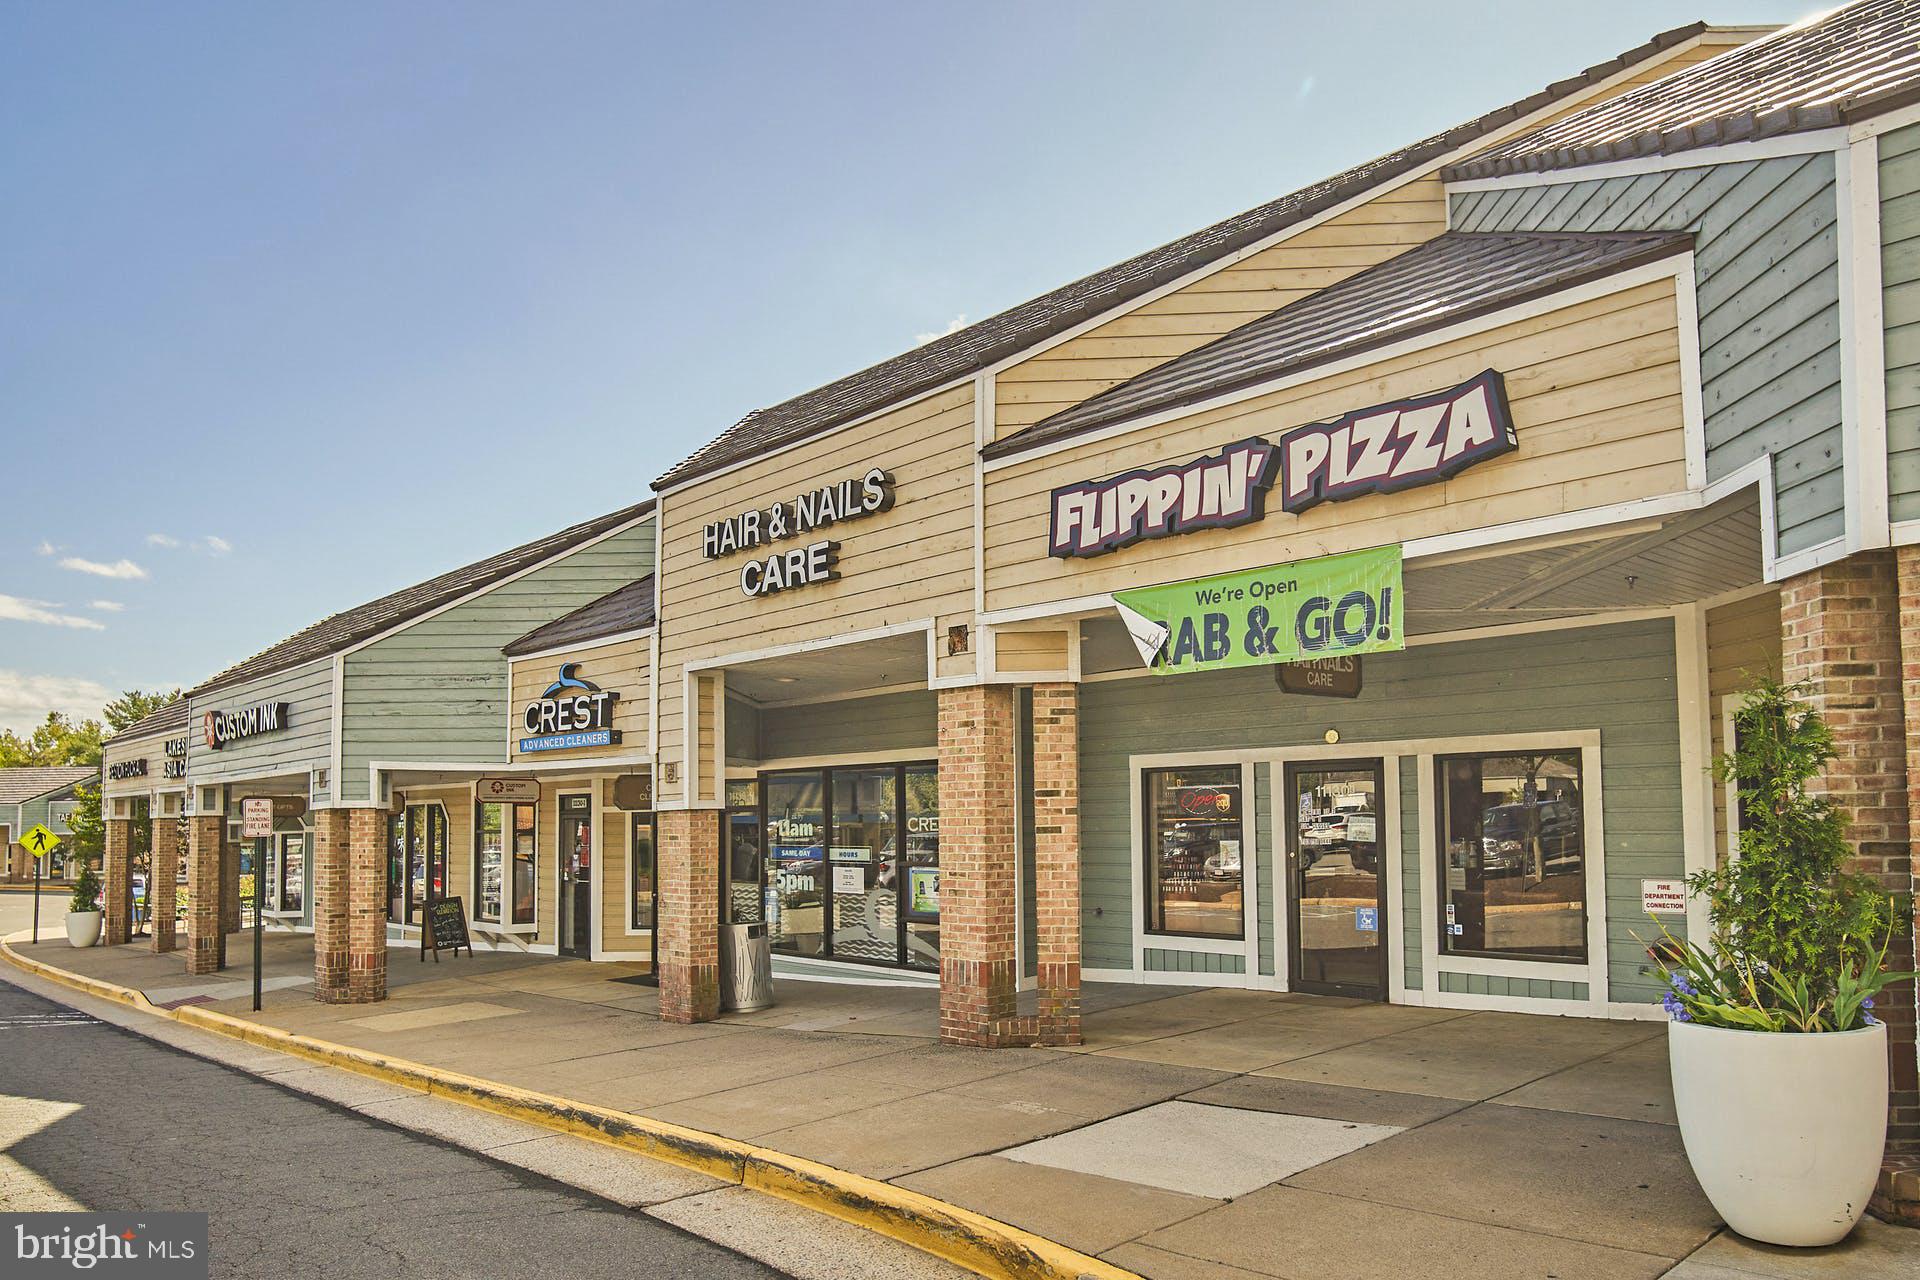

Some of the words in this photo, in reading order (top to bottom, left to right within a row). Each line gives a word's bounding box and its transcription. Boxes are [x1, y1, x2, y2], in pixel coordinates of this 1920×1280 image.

[1055, 449, 1265, 549] FLIPPIN'
[1288, 384, 1496, 498] PIZZA
[703, 510, 761, 558] HAIR
[768, 502, 788, 538] &
[796, 468, 886, 532] NAILS
[741, 540, 831, 596] CARE
[1196, 587, 1244, 607] We're
[1249, 579, 1298, 601] Open
[1244, 604, 1280, 658] &
[1296, 587, 1393, 651] GO!
[1307, 671, 1334, 687] CARE
[215, 707, 257, 742] CUSTOM
[260, 702, 279, 732] INK
[524, 692, 609, 734] CREST
[523, 738, 565, 750] ADVANCED
[566, 733, 608, 745] CLEANERS
[777, 869, 815, 893] 5pm
